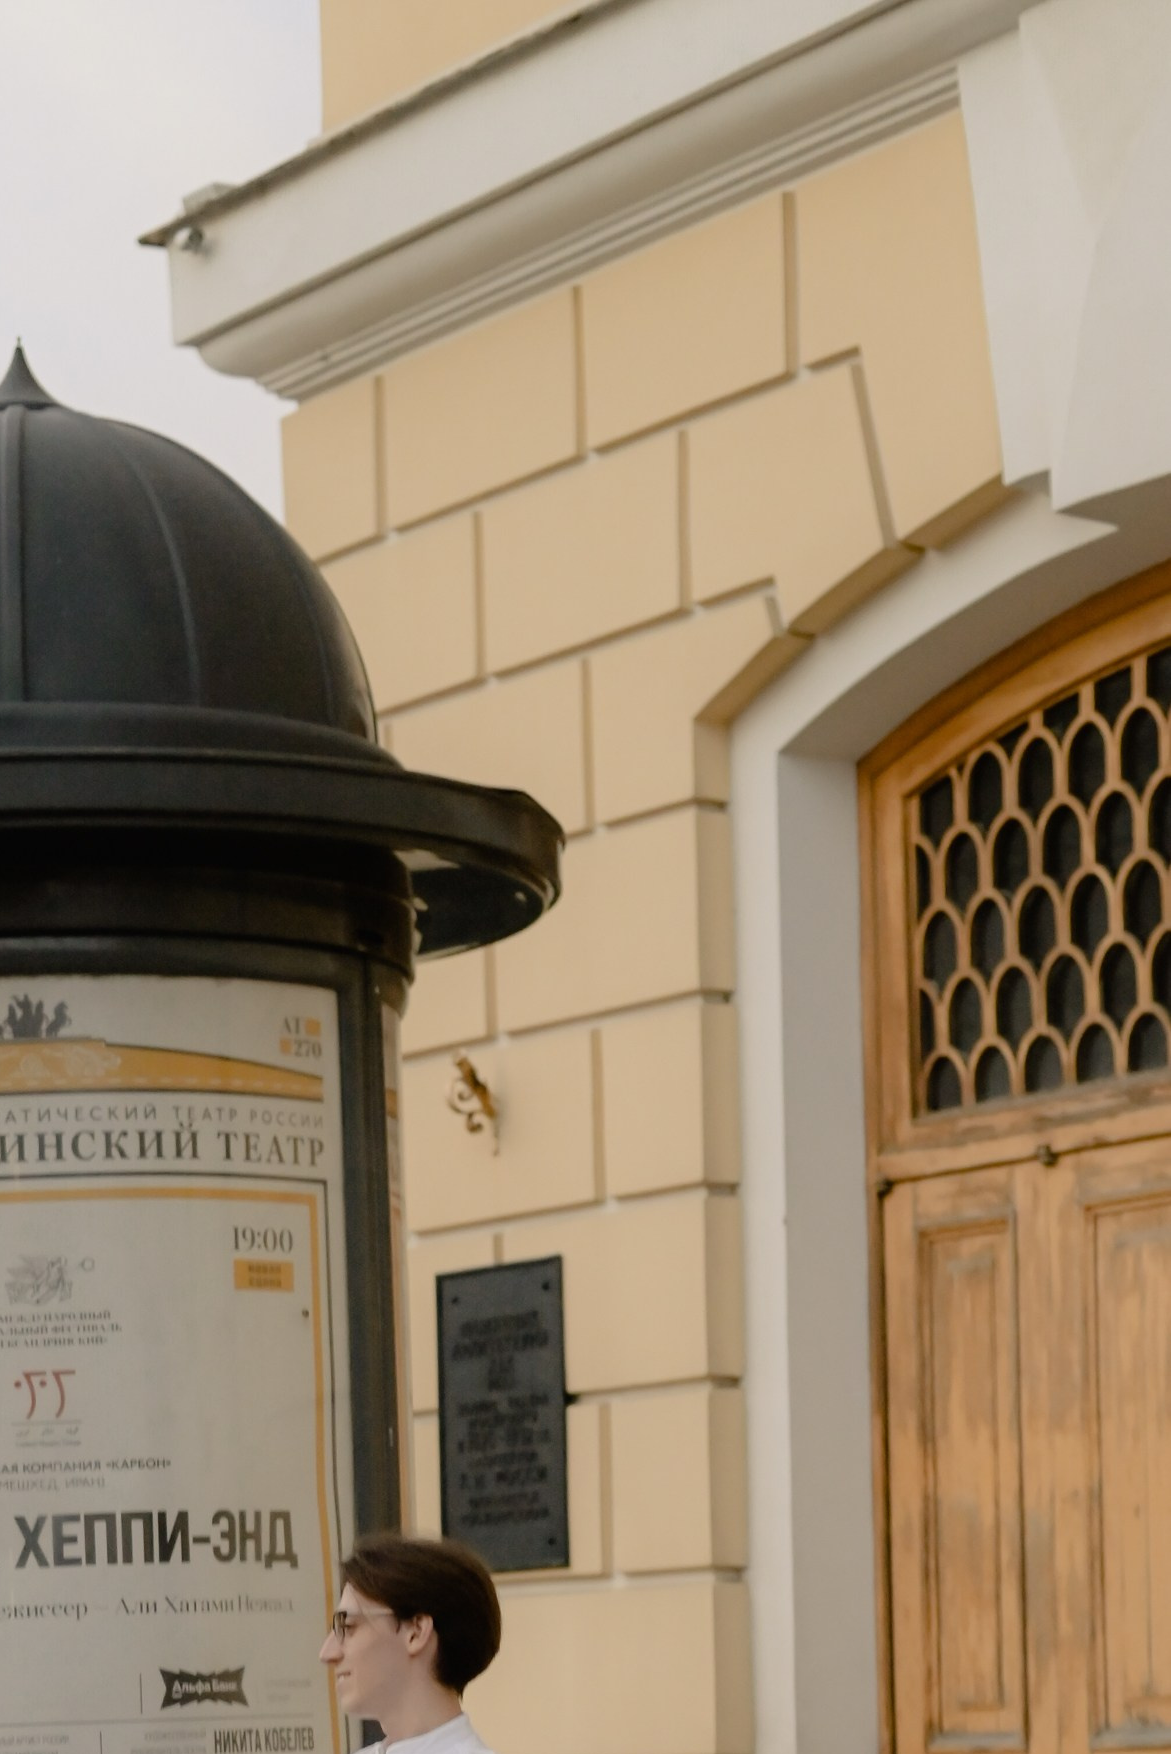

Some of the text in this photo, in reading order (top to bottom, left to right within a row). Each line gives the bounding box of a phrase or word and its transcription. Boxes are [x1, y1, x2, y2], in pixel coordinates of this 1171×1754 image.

[172, 1105, 238, 1123] ТЕАТР
[249, 1109, 324, 1128] РОССИИ
[216, 1130, 325, 1167] ТЕАТР
[233, 1225, 294, 1254] 19:00
[22, 1460, 102, 1475] КОМПАНИЯ
[13, 1508, 299, 1570] ХЕППИ-ЭНД
[116, 1597, 159, 1616] Али
[172, 1679, 211, 1699] Альфа
[263, 1726, 316, 1753] КОБЕЛЕВ
